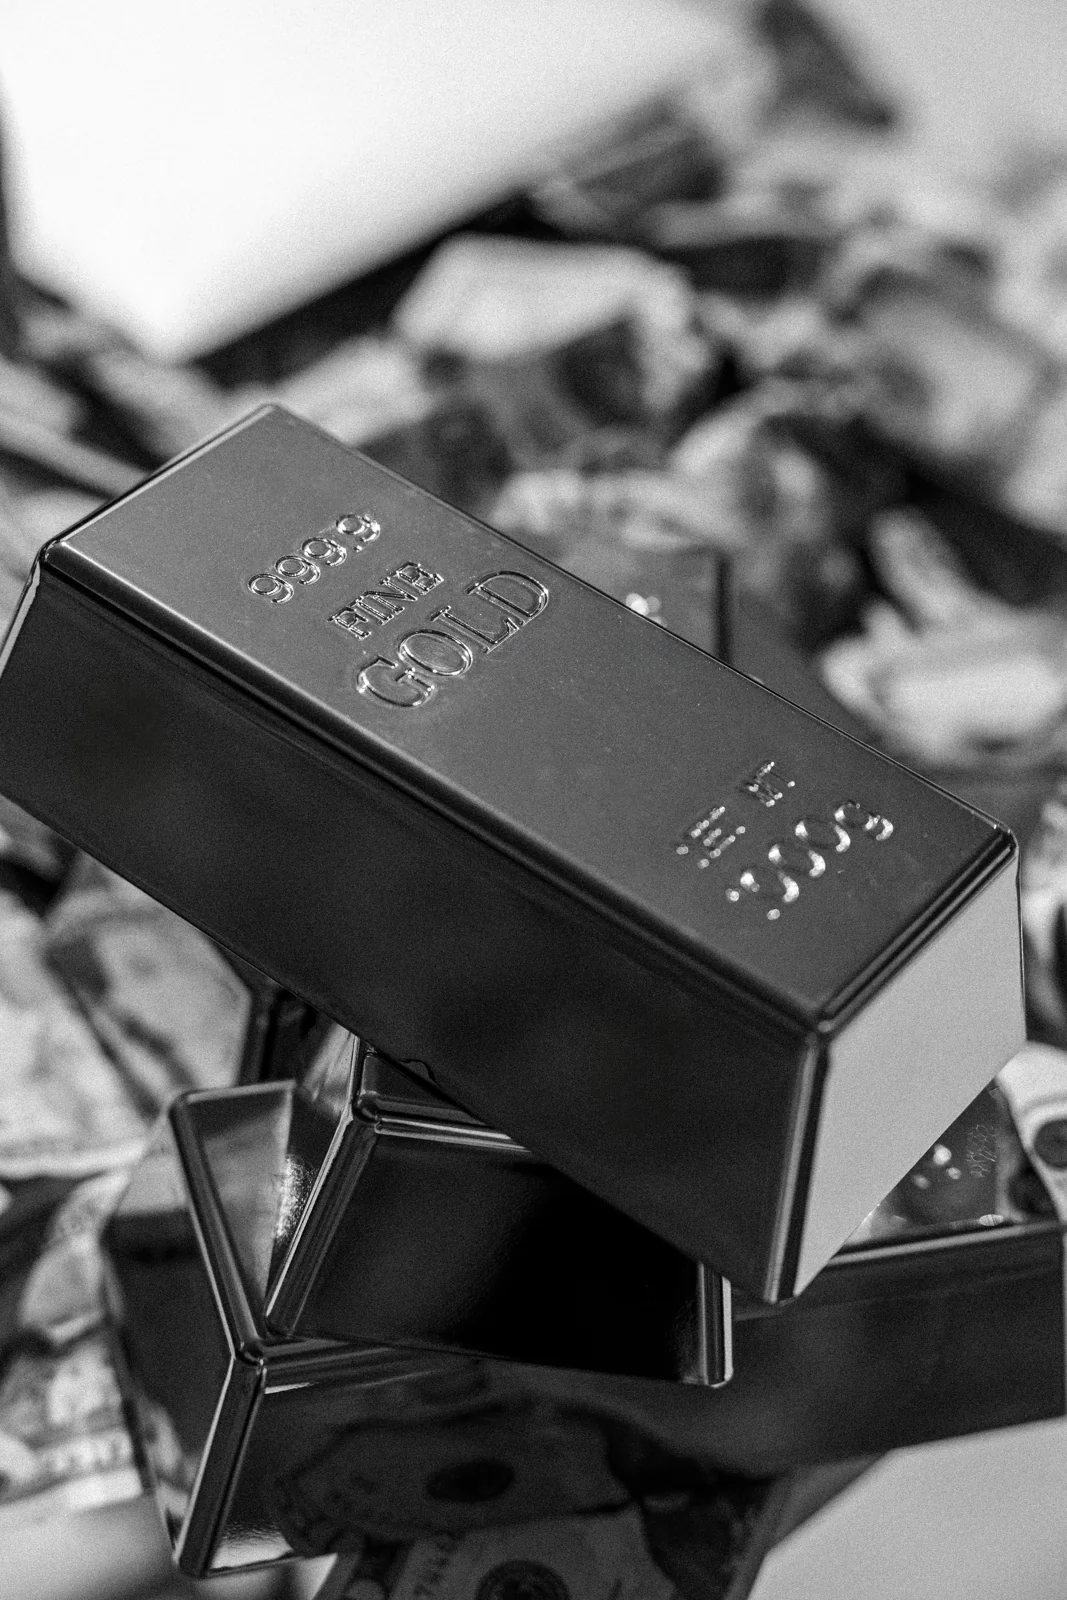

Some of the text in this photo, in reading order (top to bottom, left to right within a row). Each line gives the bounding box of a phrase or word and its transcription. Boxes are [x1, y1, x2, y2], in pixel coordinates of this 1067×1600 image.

[248, 513, 381, 604] 999.9
[327, 561, 445, 641] FINE
[355, 570, 549, 708] GOLD
